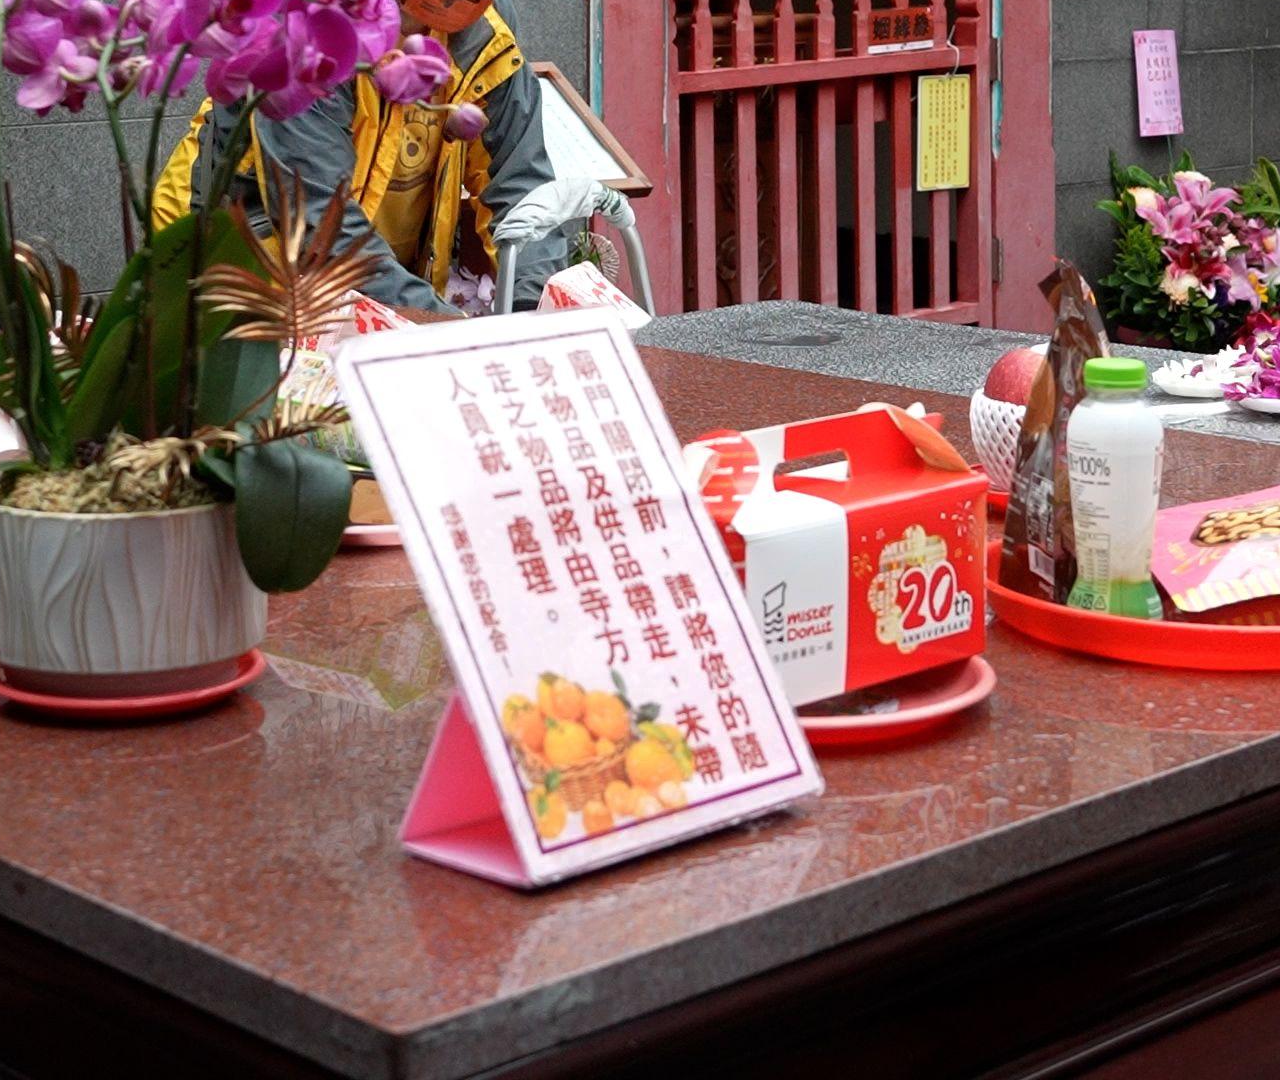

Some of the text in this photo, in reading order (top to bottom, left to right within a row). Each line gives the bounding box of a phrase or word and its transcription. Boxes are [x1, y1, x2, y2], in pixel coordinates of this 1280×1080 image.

[483, 360, 631, 668] 走之物品將由寺方
[902, 564, 971, 631] 20th
